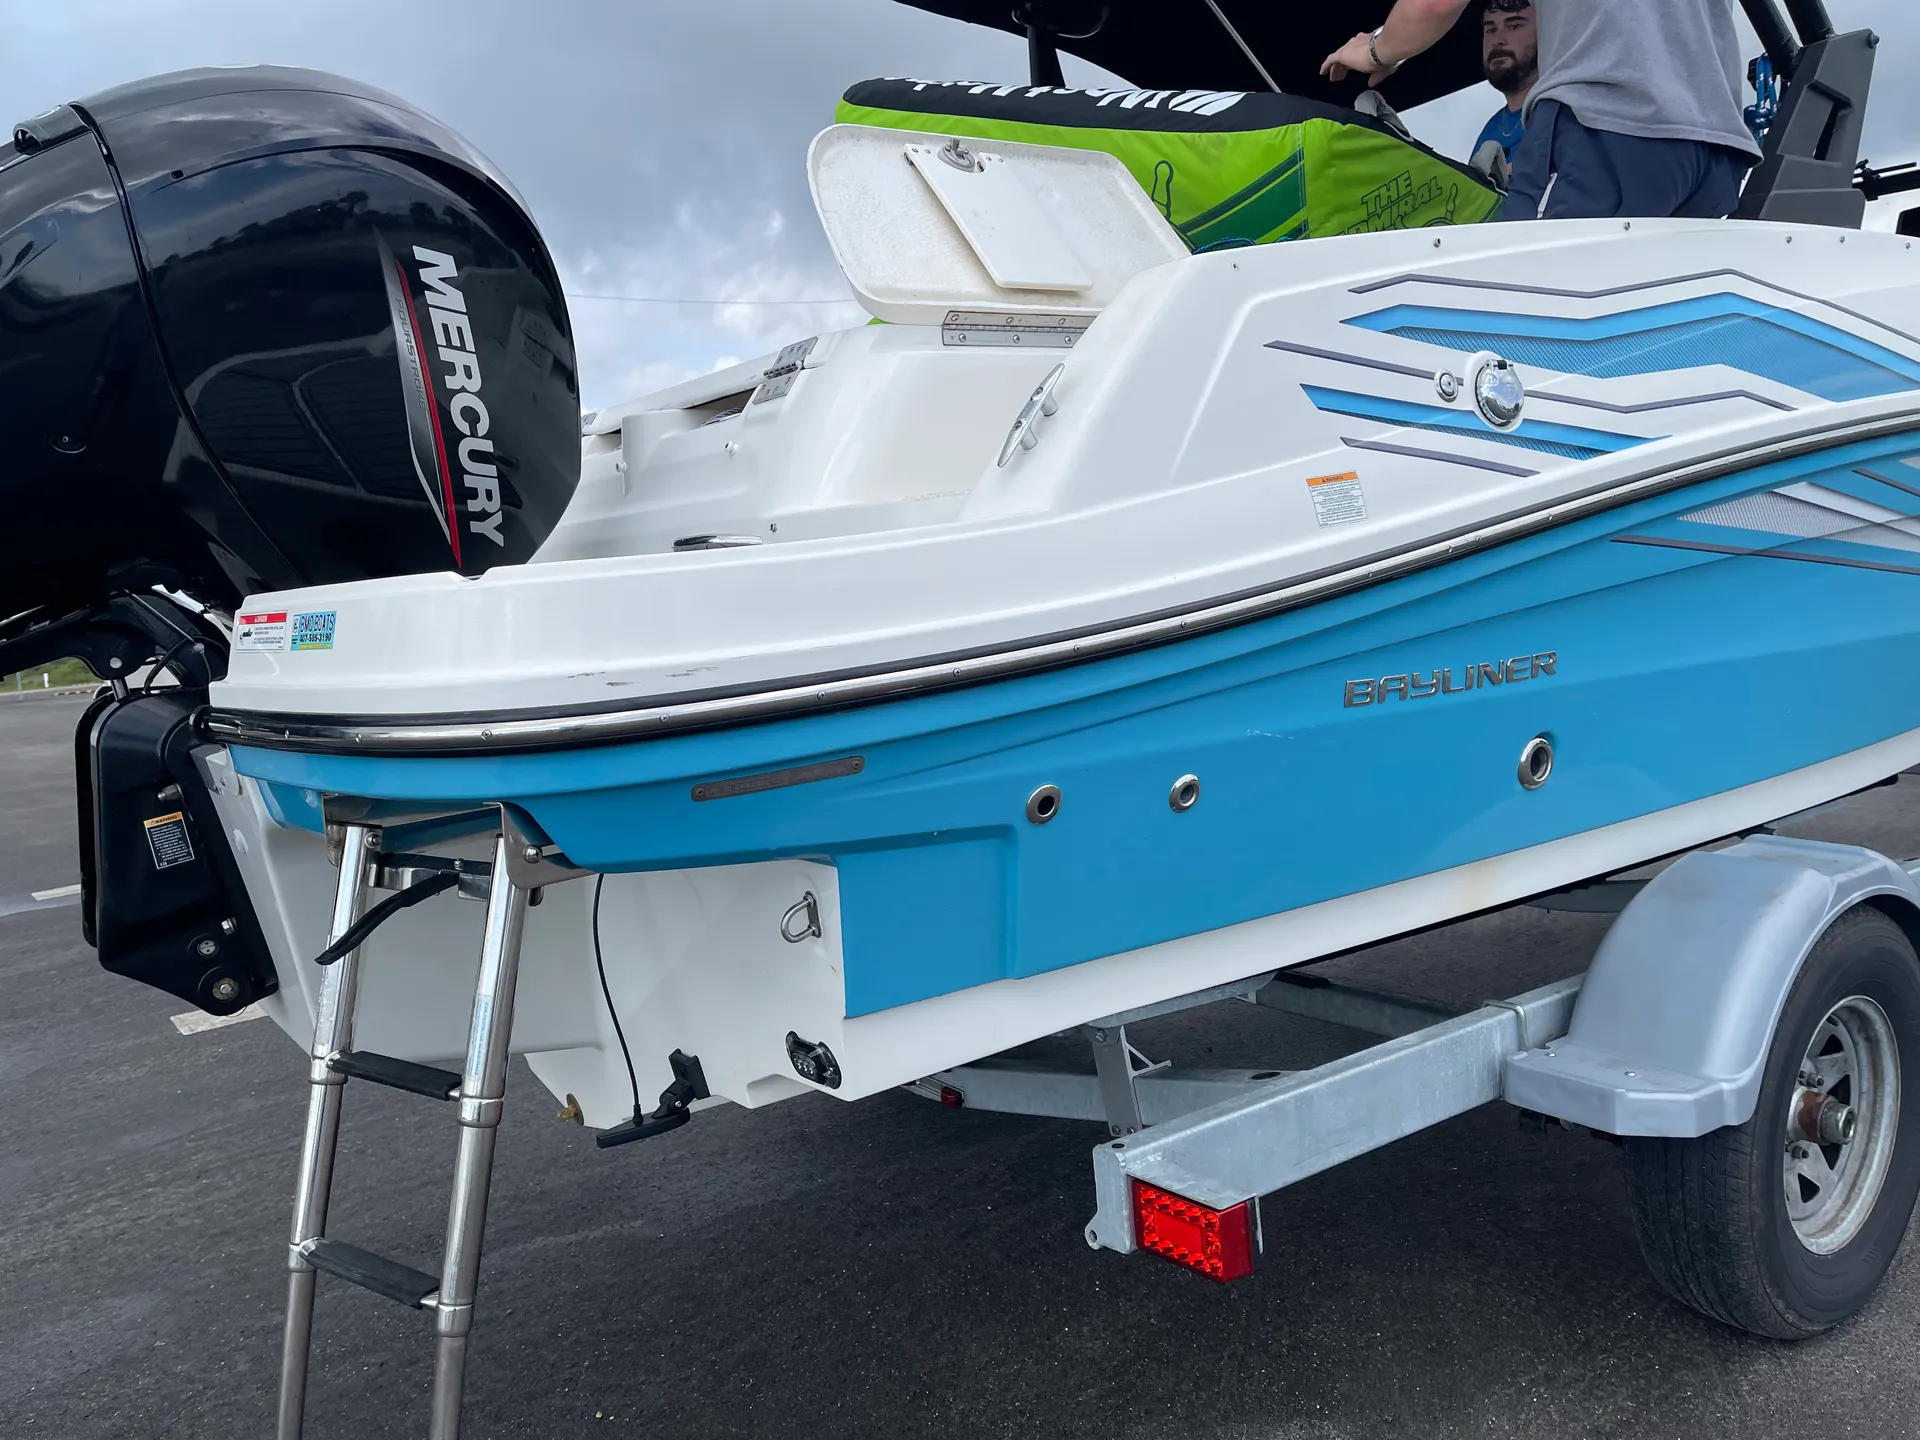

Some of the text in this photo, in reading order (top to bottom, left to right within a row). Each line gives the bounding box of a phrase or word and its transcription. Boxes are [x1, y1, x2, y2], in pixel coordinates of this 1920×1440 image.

[1361, 169, 1413, 217] THE
[395, 297, 426, 410] FOURSTROKE
[412, 245, 504, 547] MERCURY
[314, 613, 335, 632] BOATS
[1344, 650, 1557, 708] BAYLINER
[156, 815, 177, 824] WARNING
